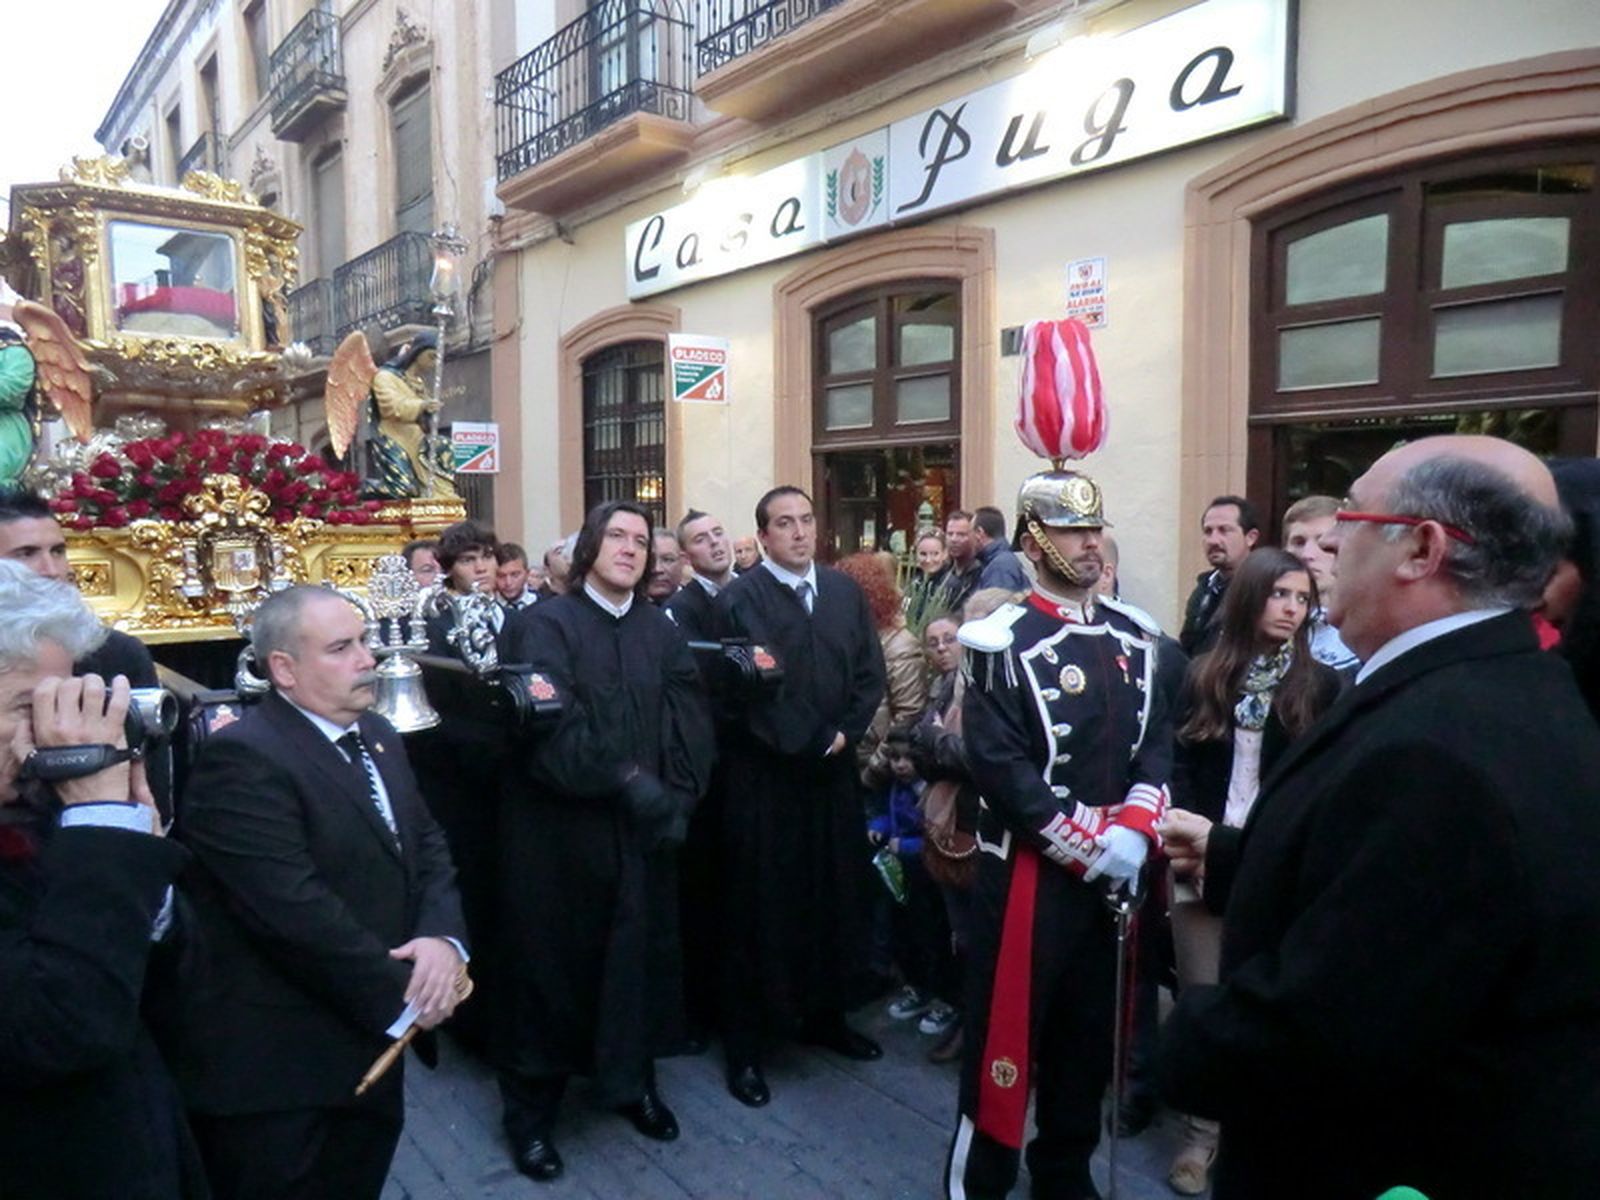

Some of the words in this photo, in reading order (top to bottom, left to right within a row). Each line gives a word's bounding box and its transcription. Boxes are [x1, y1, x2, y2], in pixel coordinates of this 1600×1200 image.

[633, 196, 805, 282] Casa
[896, 45, 1244, 213] Puga
[45, 755, 89, 766] SONY
